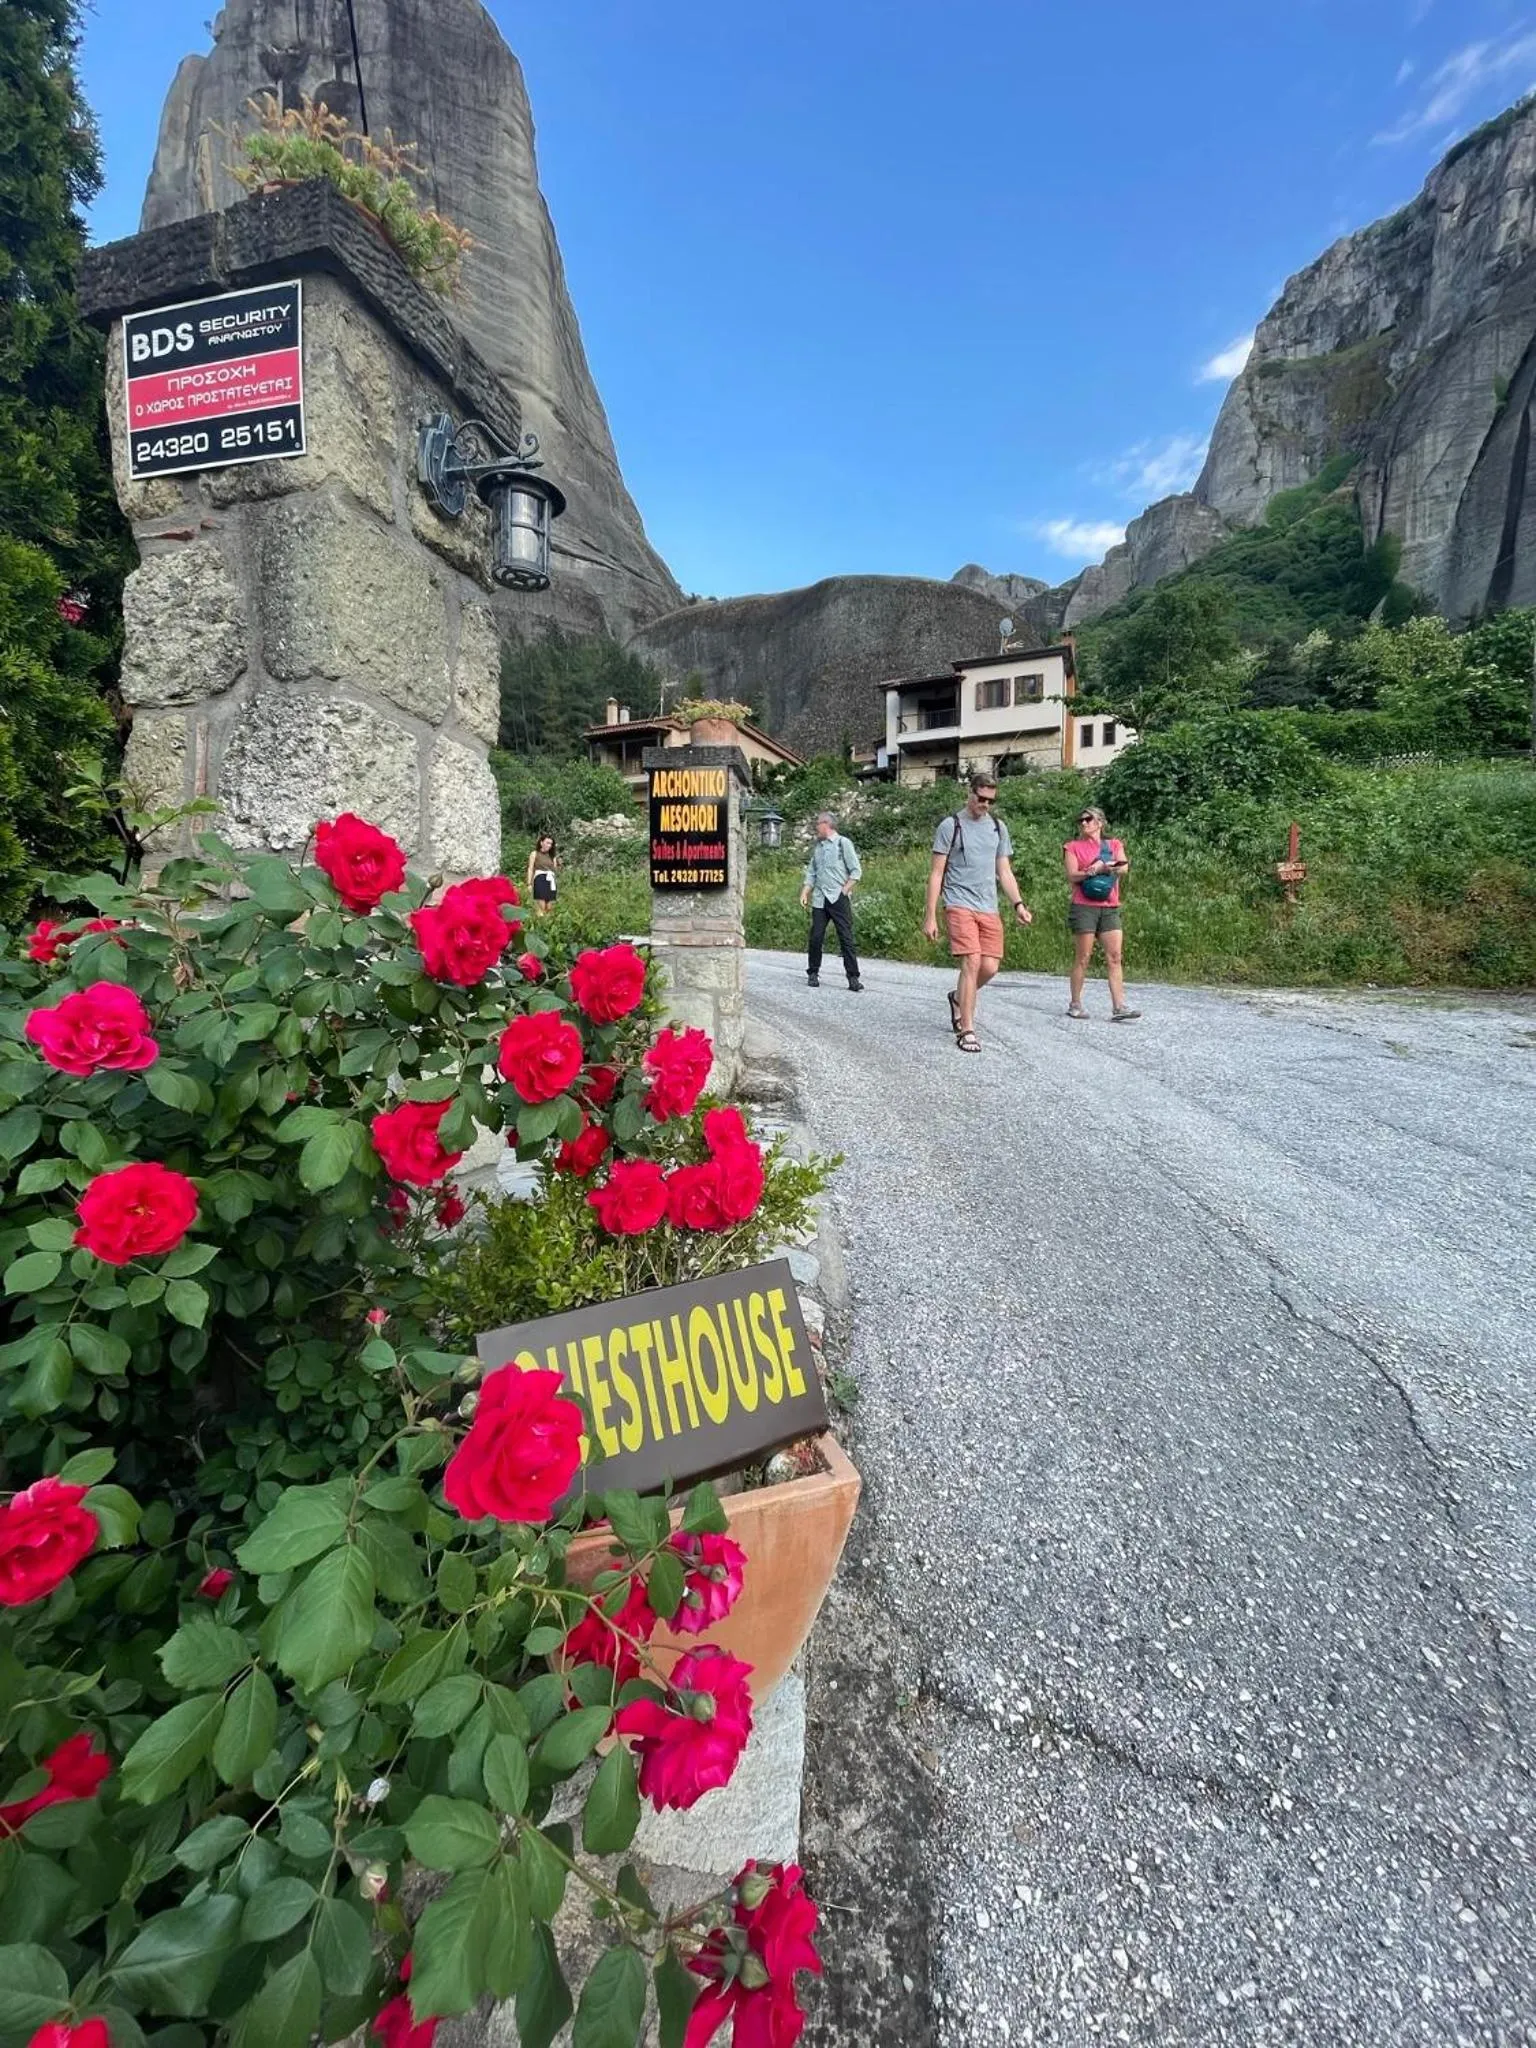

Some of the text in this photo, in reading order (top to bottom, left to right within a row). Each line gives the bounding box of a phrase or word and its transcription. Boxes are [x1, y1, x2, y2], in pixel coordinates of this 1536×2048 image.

[199, 304, 291, 333] SECURITY
[132, 323, 195, 362] BDS
[208, 324, 283, 346] ΑΝΑΓΝΩΣΤΟΥ
[167, 364, 257, 392] ΠΡΟΣΟΧΗ
[147, 396, 185, 414] ΧΩΡΟΣ
[187, 376, 293, 407] ΠΡΟΣΤΑΤΕΥΕΤΑΙ
[136, 418, 296, 462] 24320 25151
[652, 770, 726, 798] ARCHONTIKO
[660, 804, 718, 832] MESOHORI
[652, 839, 675, 860] Suites
[682, 839, 725, 866] Apartments
[671, 870, 698, 883] 24320
[700, 869, 724, 883] 77125
[513, 1288, 807, 1465] UESTHOUSE
